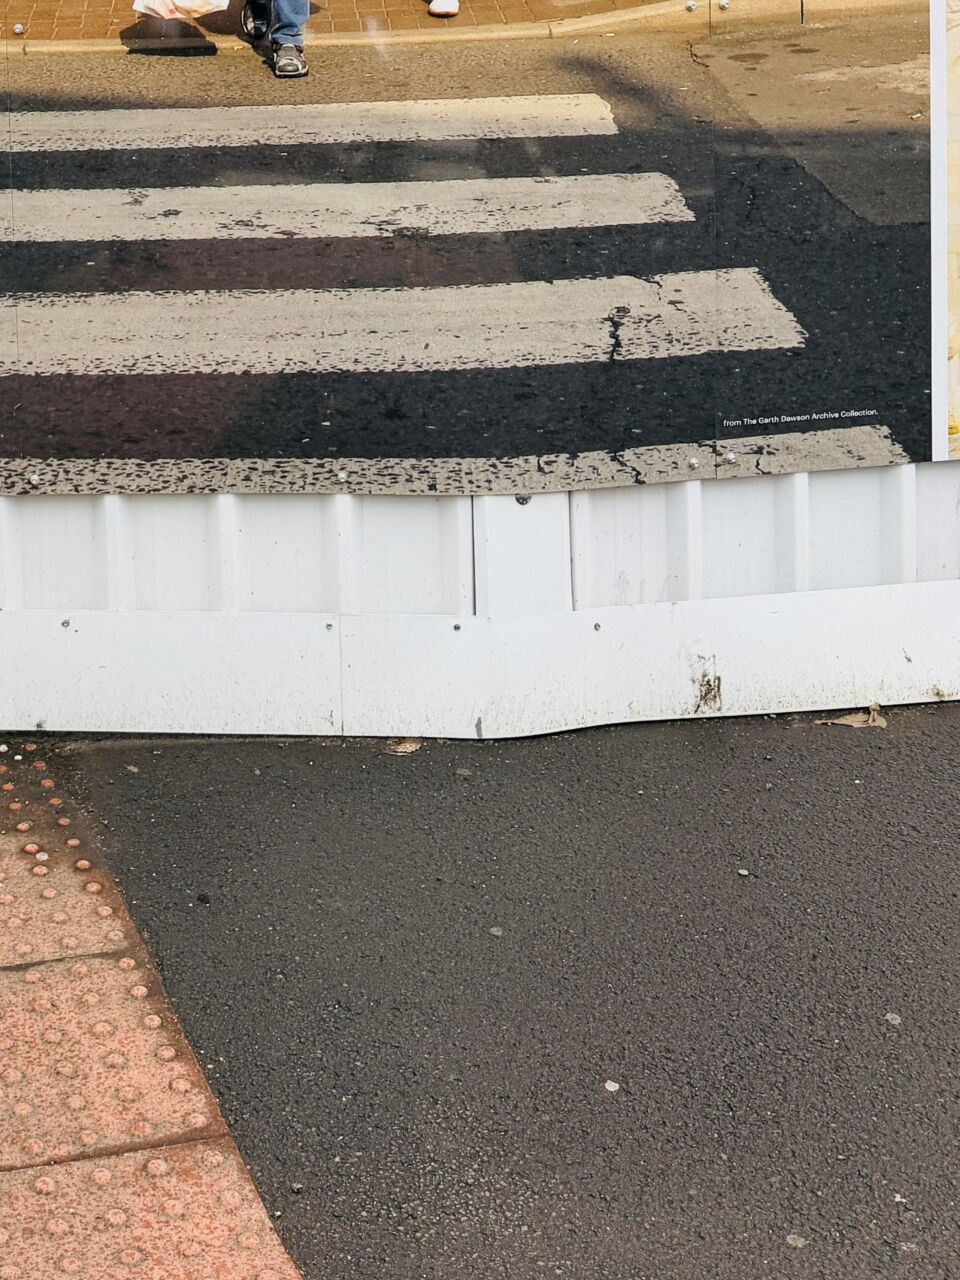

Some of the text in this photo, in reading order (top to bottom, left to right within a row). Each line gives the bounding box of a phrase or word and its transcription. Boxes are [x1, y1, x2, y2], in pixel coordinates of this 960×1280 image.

[743, 418, 758, 426] The
[758, 416, 780, 424] Garth
[781, 414, 810, 423] Dawson
[811, 411, 840, 420] Archive
[840, 408, 879, 418] Collection.
